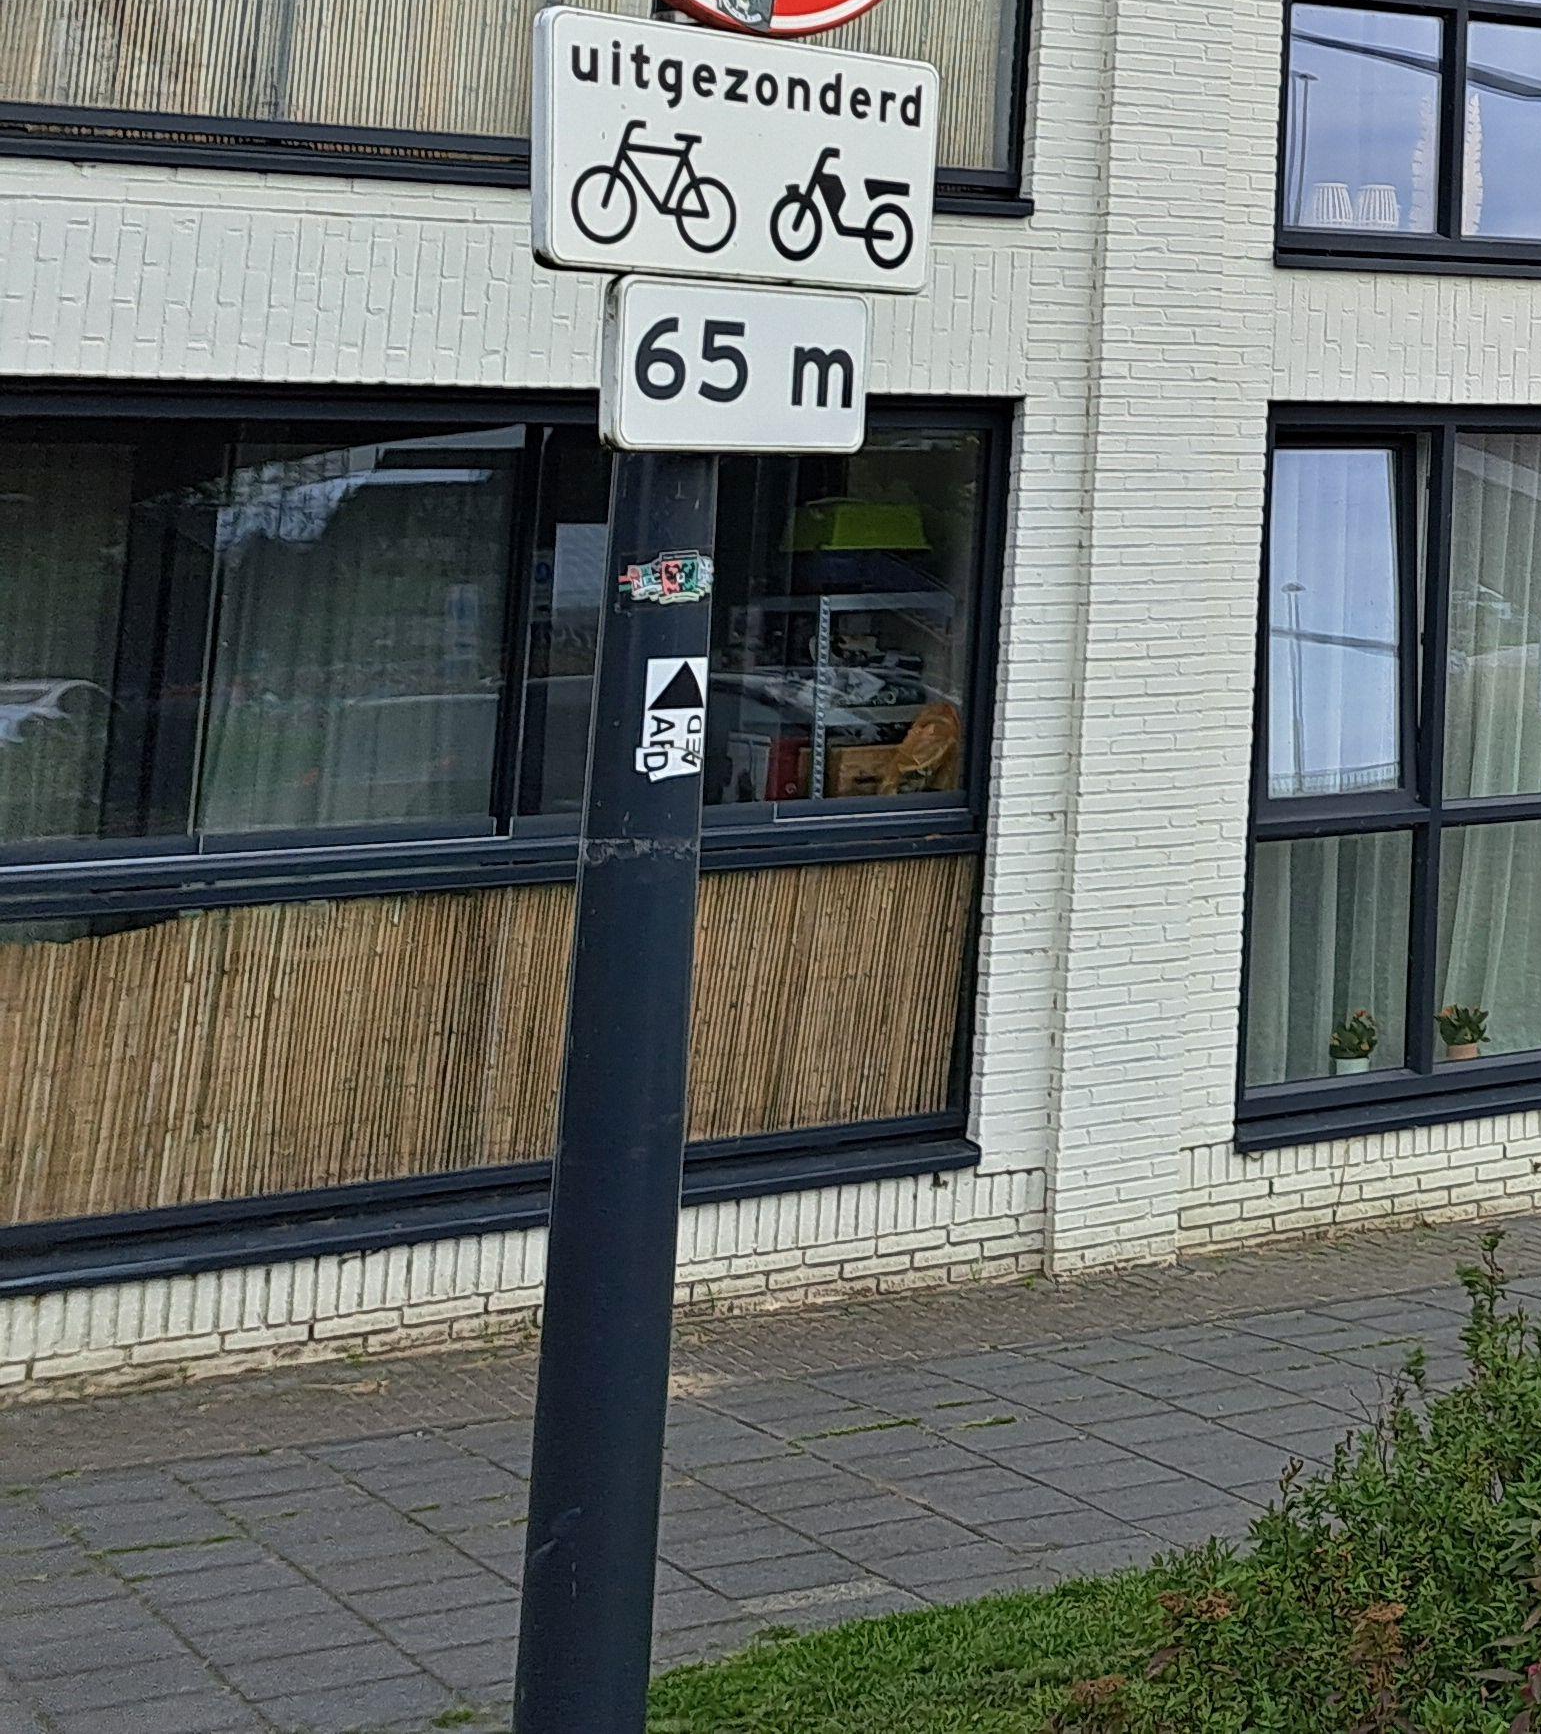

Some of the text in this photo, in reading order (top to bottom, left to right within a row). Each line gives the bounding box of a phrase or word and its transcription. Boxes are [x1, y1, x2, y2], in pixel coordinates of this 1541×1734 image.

[571, 40, 923, 127] uitgezonderd
[635, 317, 854, 409] 65 m
